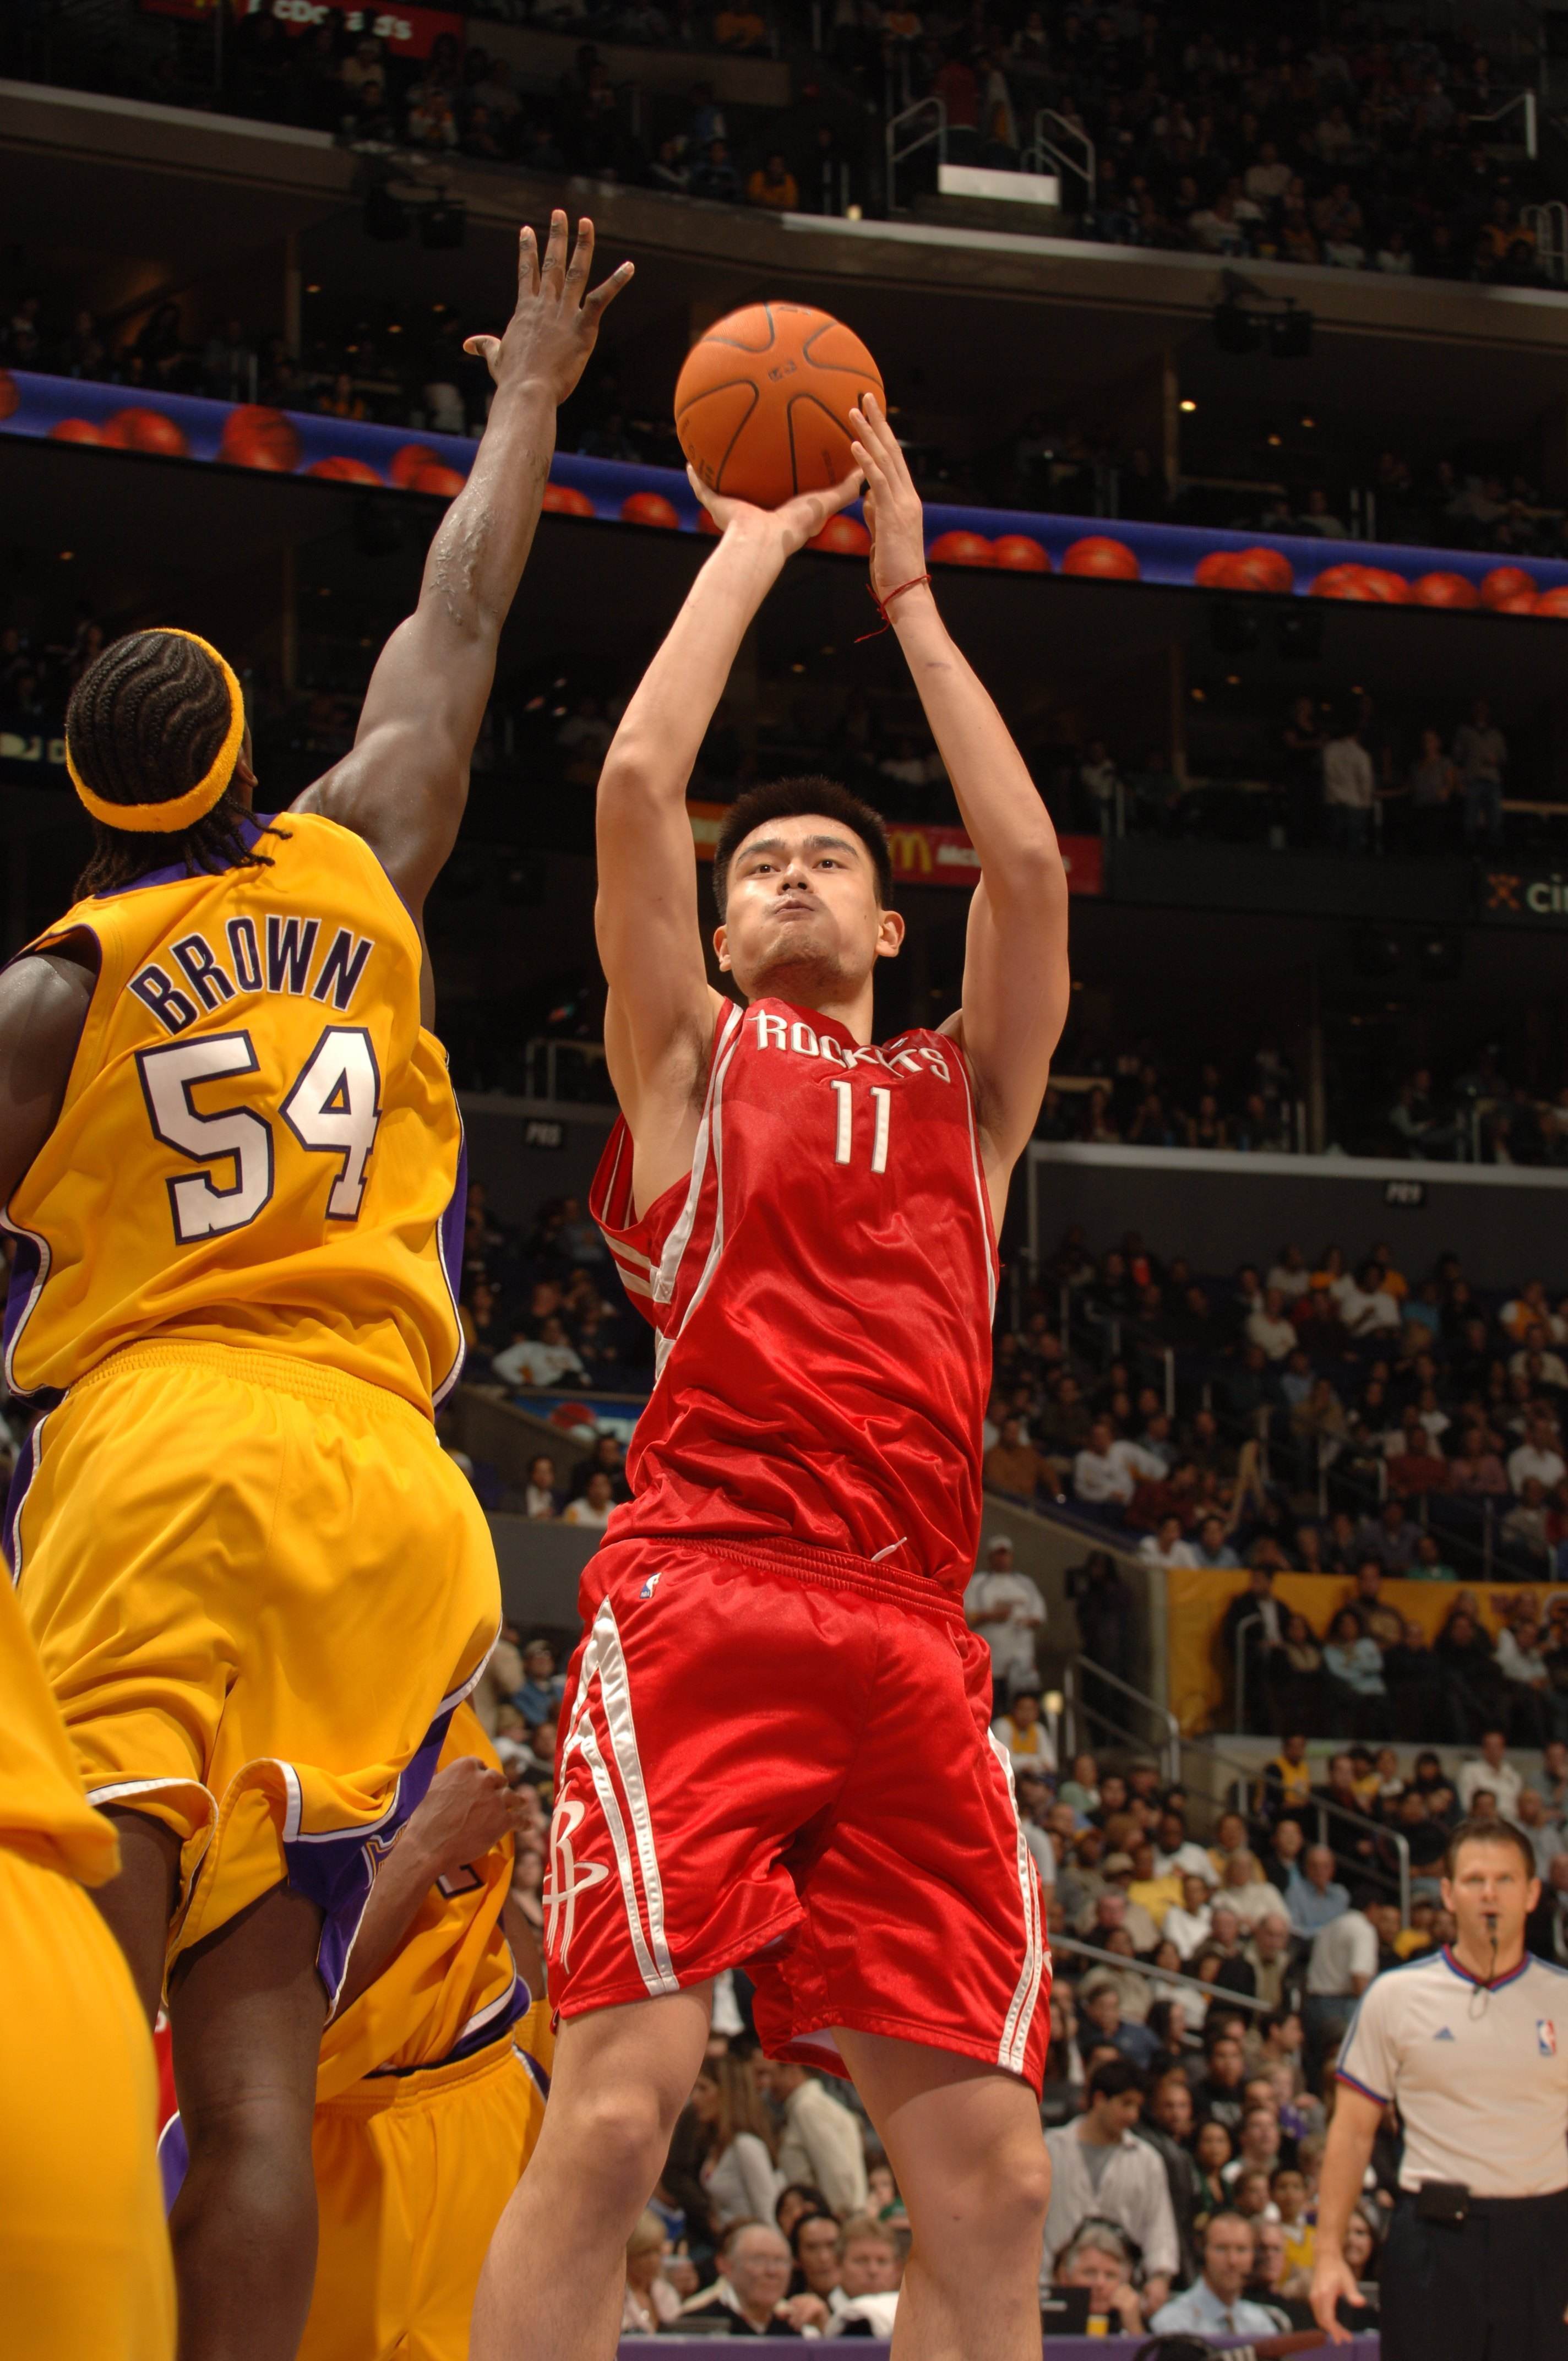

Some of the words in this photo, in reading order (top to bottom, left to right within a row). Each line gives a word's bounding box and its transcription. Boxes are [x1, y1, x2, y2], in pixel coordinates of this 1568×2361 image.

[1526, 873, 1568, 913] ci
[126, 913, 375, 1036] BROWN
[135, 1025, 383, 1245] 54
[831, 1080, 891, 1174] 11
